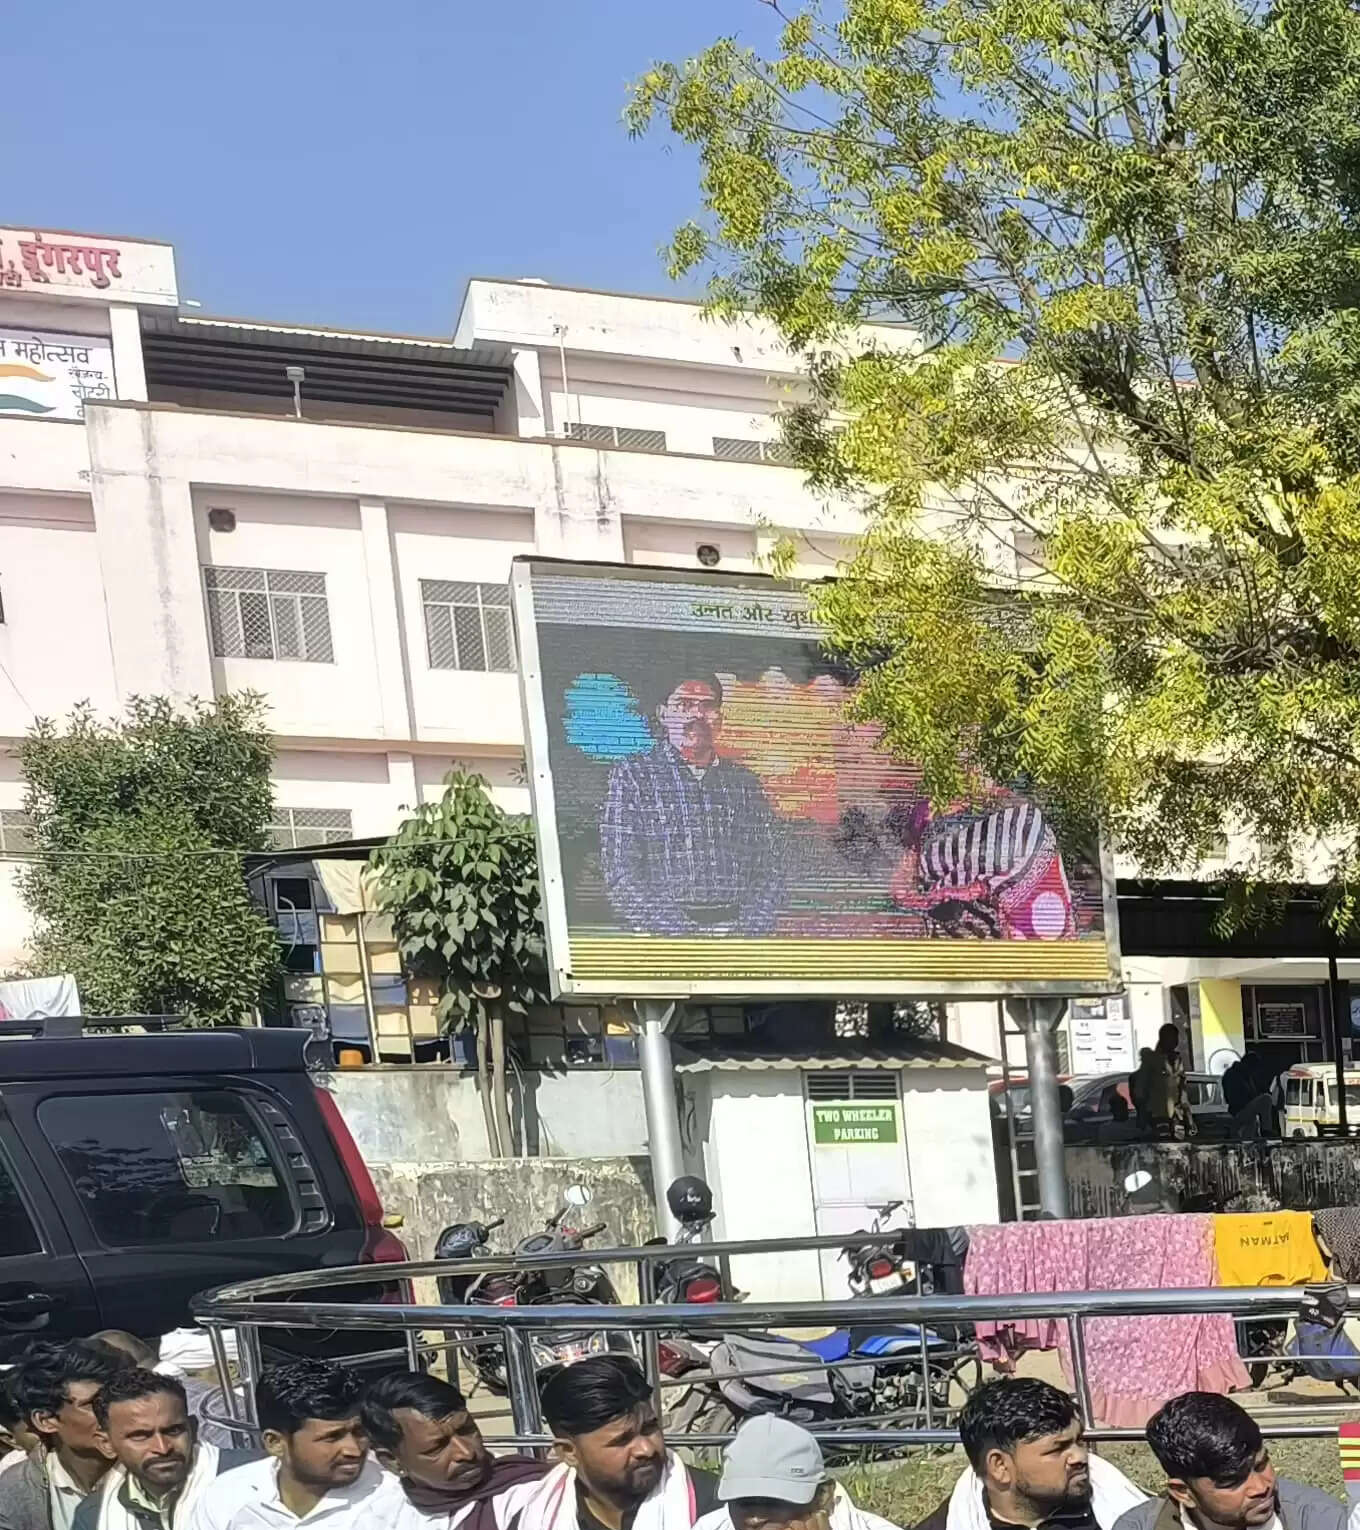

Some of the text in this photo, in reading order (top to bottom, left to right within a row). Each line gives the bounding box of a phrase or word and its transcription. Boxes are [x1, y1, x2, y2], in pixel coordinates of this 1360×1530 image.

[11, 336, 94, 365] महोत्सव
[743, 603, 773, 622] और
[815, 1109, 893, 1123] TWO WHEELER
[833, 1127, 880, 1141] PARKING
